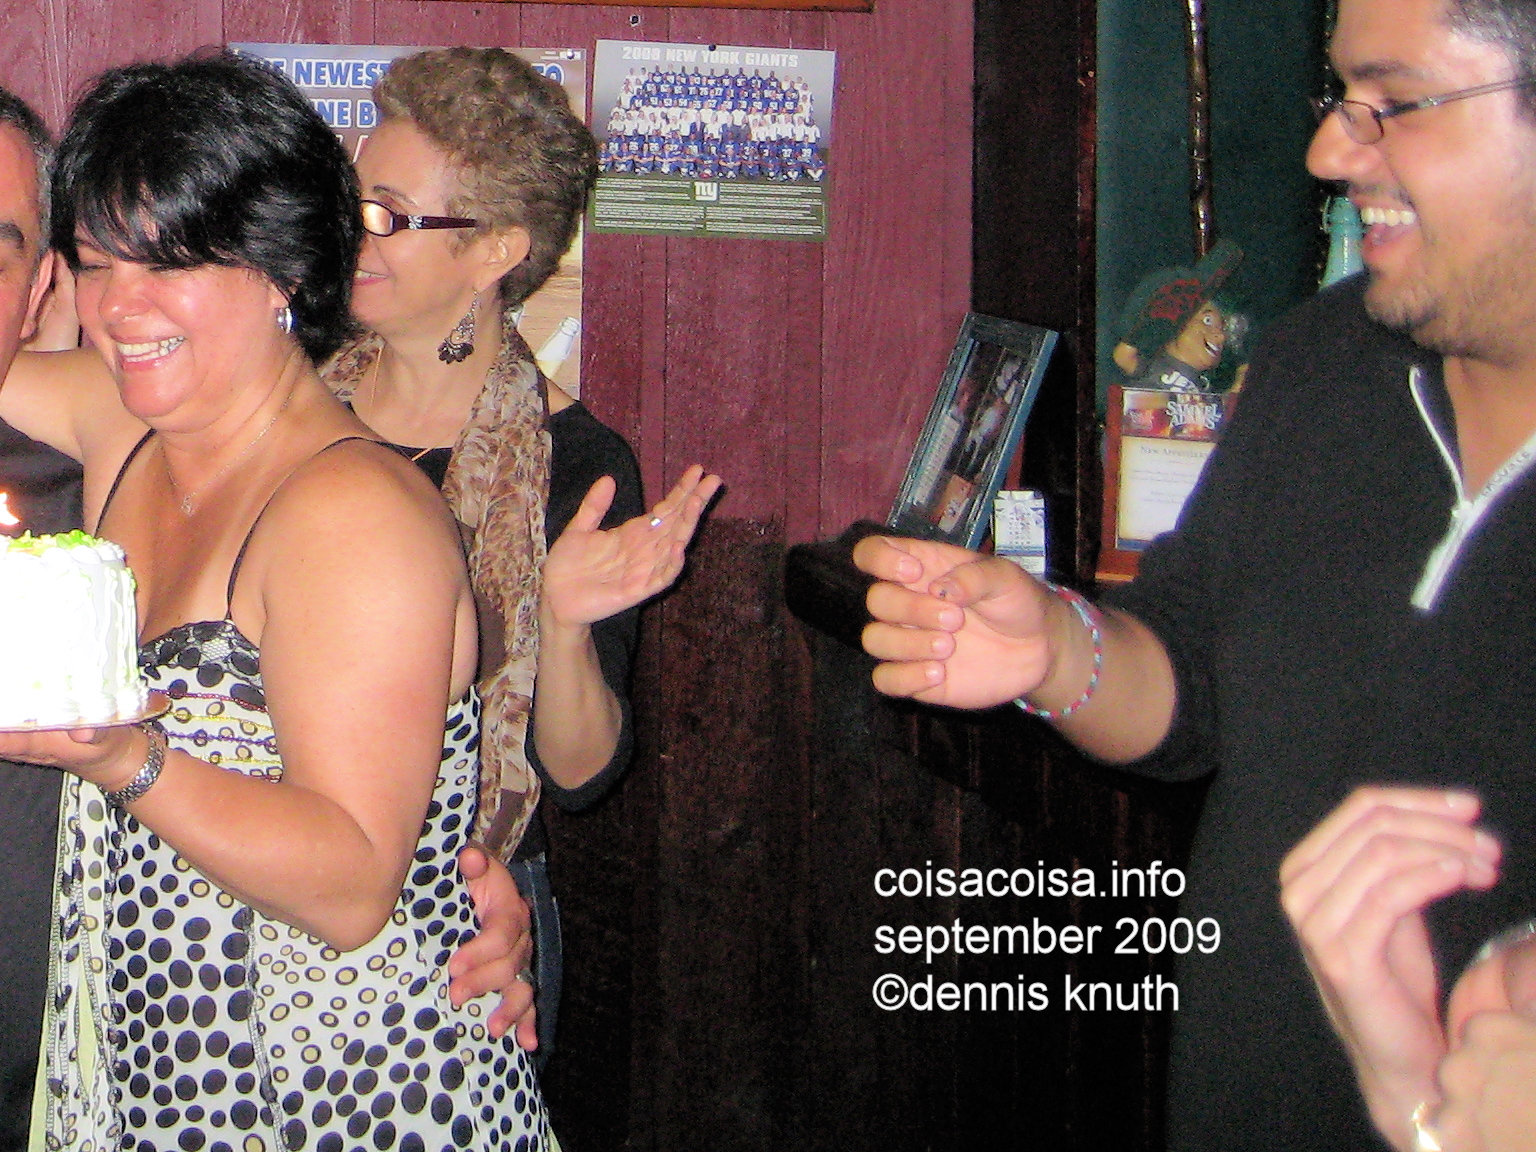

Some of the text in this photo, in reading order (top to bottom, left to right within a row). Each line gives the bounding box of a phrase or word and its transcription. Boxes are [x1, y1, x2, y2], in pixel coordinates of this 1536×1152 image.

[666, 48, 697, 63] NEW
[701, 50, 740, 65] YORK
[745, 53, 799, 68] GIANTS
